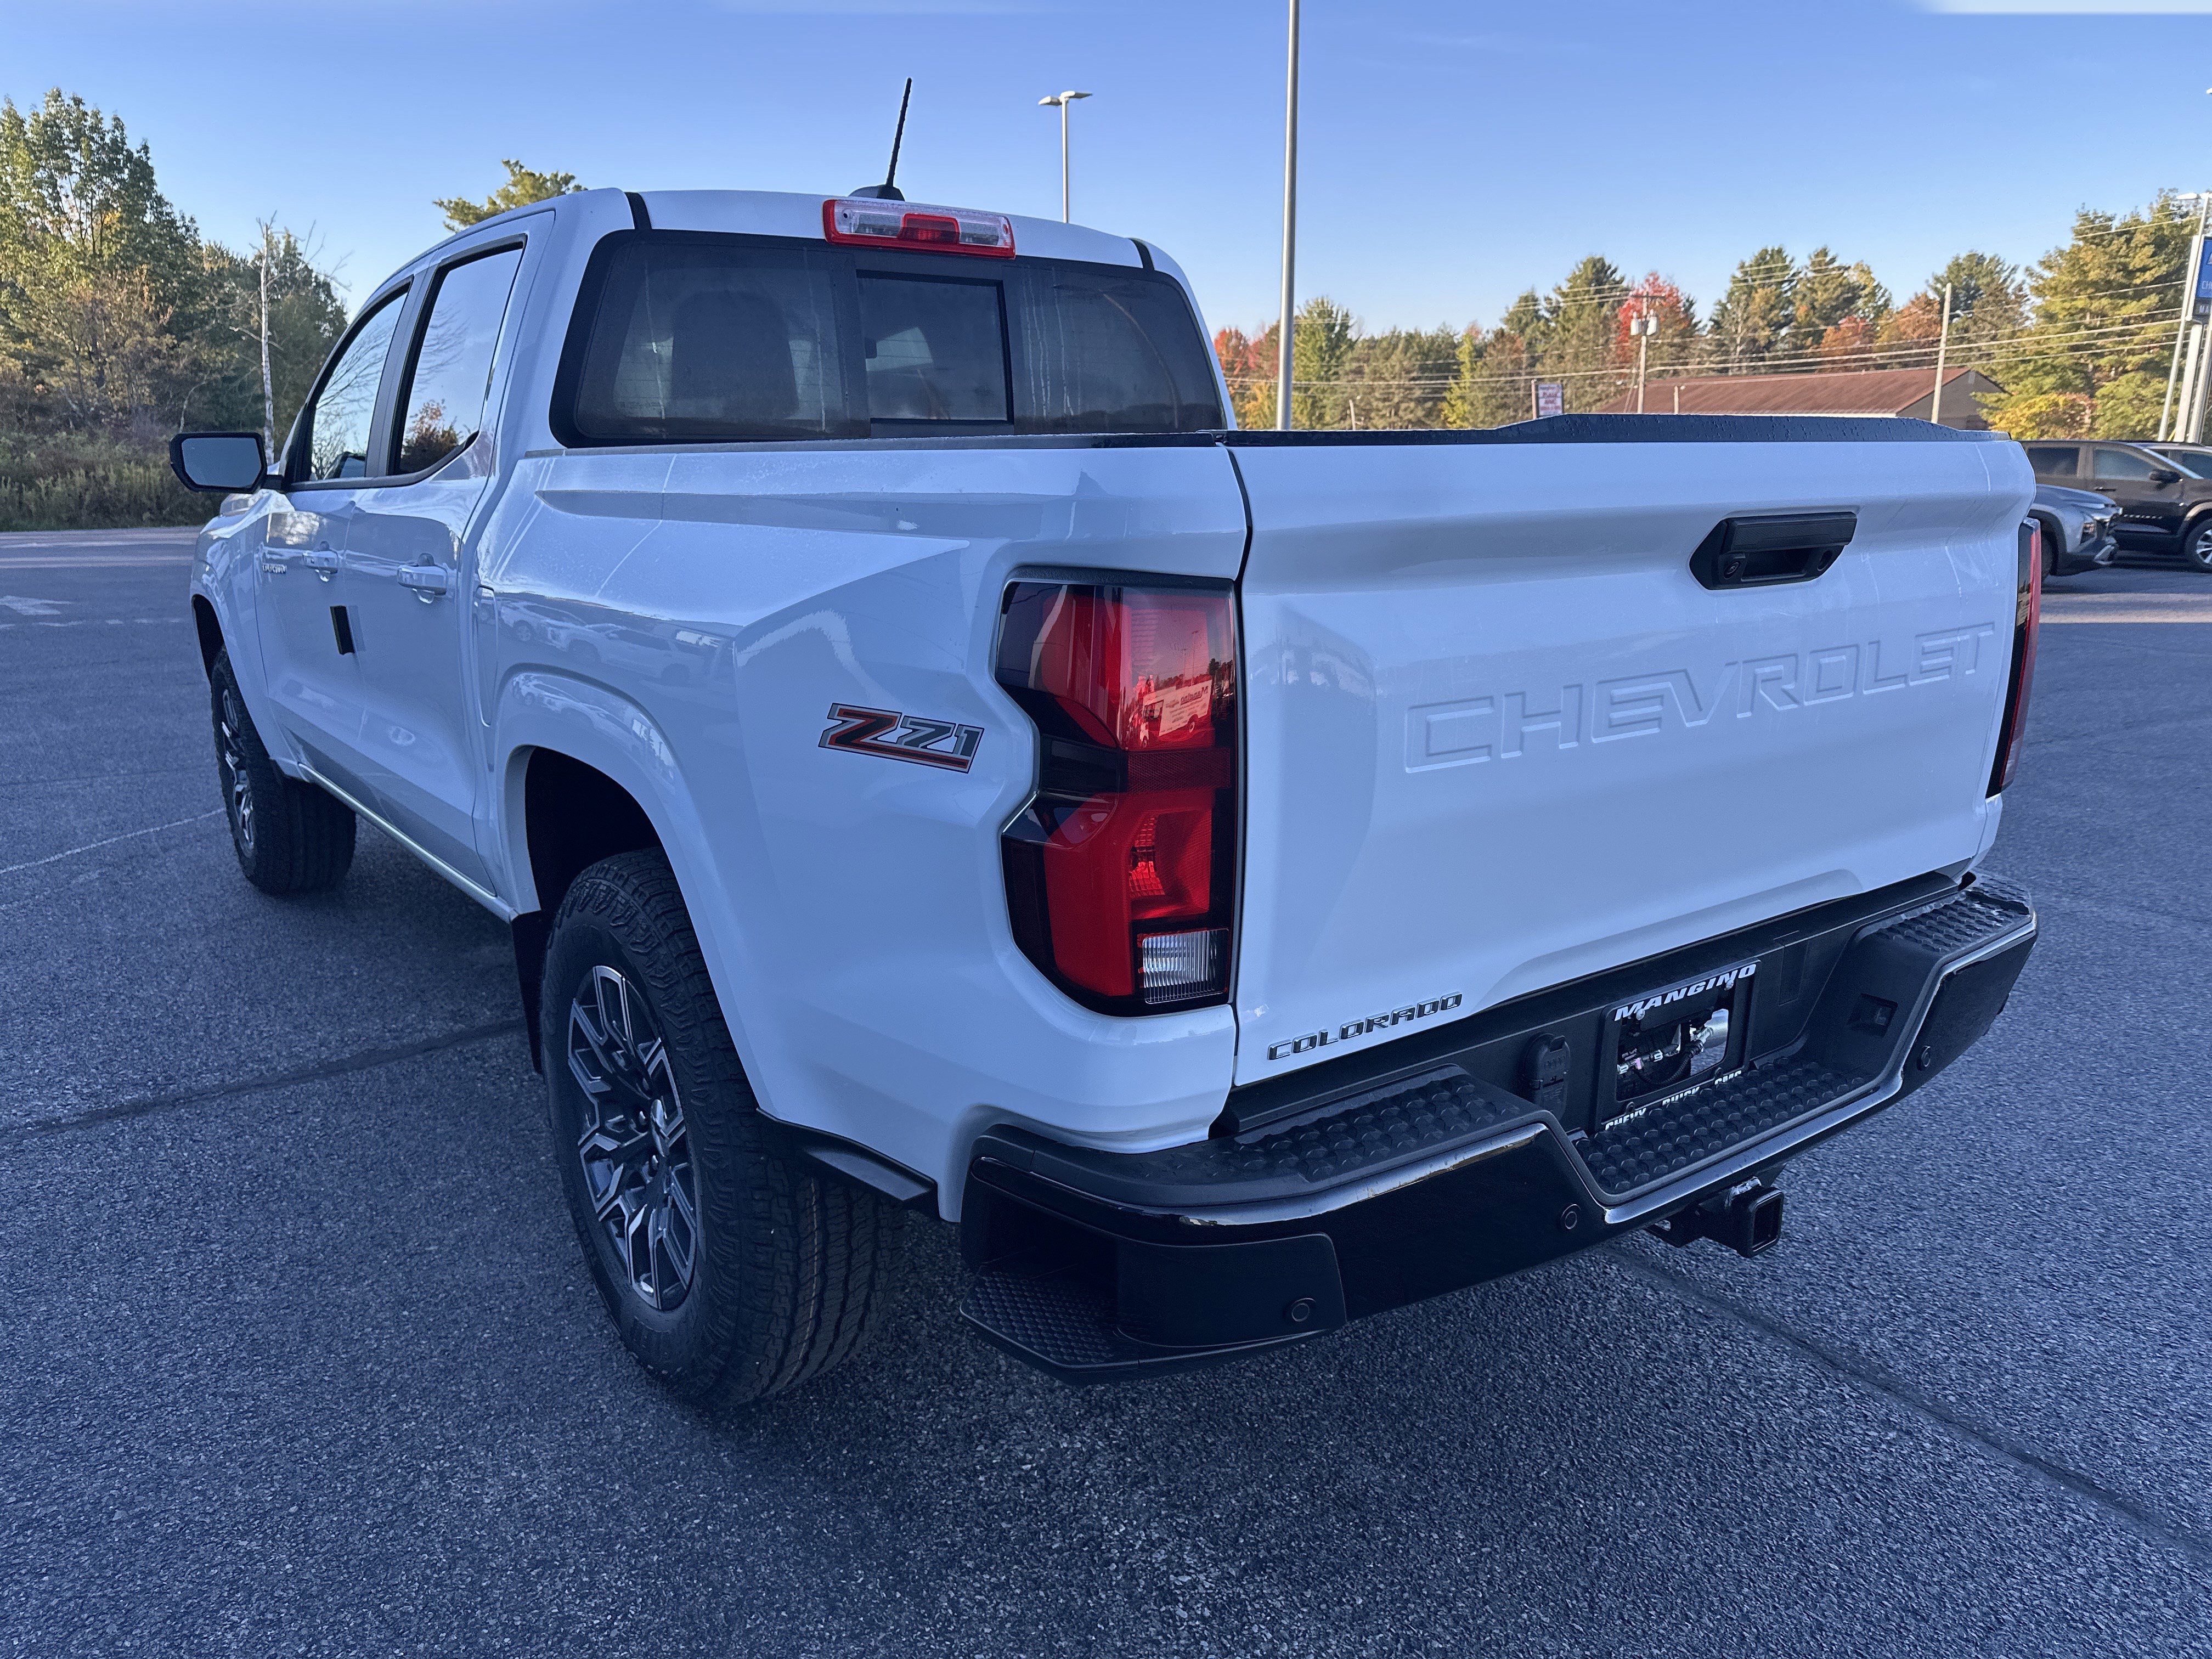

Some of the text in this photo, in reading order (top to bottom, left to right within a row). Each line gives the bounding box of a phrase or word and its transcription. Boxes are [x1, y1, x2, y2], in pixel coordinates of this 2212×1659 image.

[1405, 622, 1995, 774] CHEVROLET
[818, 703, 985, 774] Z71
[1267, 991, 1463, 1060] COLORADO
[1614, 963, 1757, 1022] MANGINO
